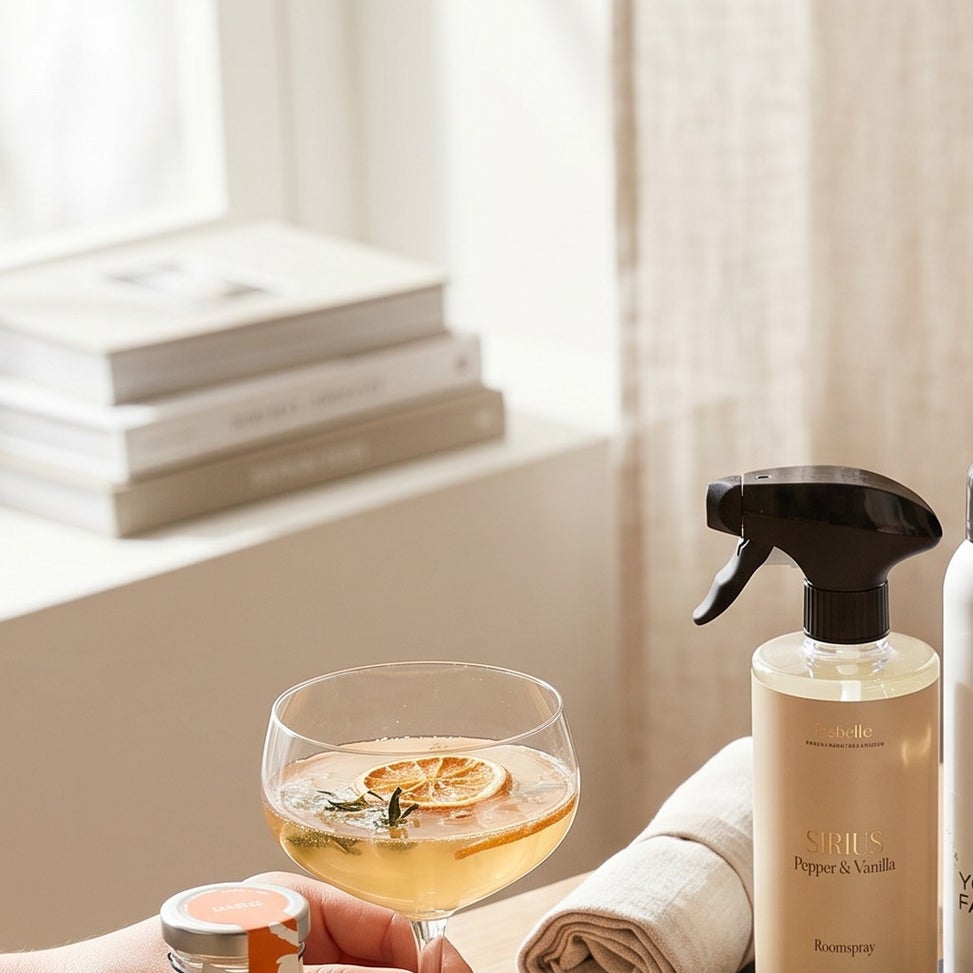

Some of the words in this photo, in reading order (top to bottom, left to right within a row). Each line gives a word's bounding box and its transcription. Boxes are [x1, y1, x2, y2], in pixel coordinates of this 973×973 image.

[806, 830, 884, 856] SIRIUS
[794, 855, 837, 877] Pepper
[839, 859, 850, 875] &
[854, 857, 896, 874] Vanilla
[814, 938, 876, 957] Roomspray
